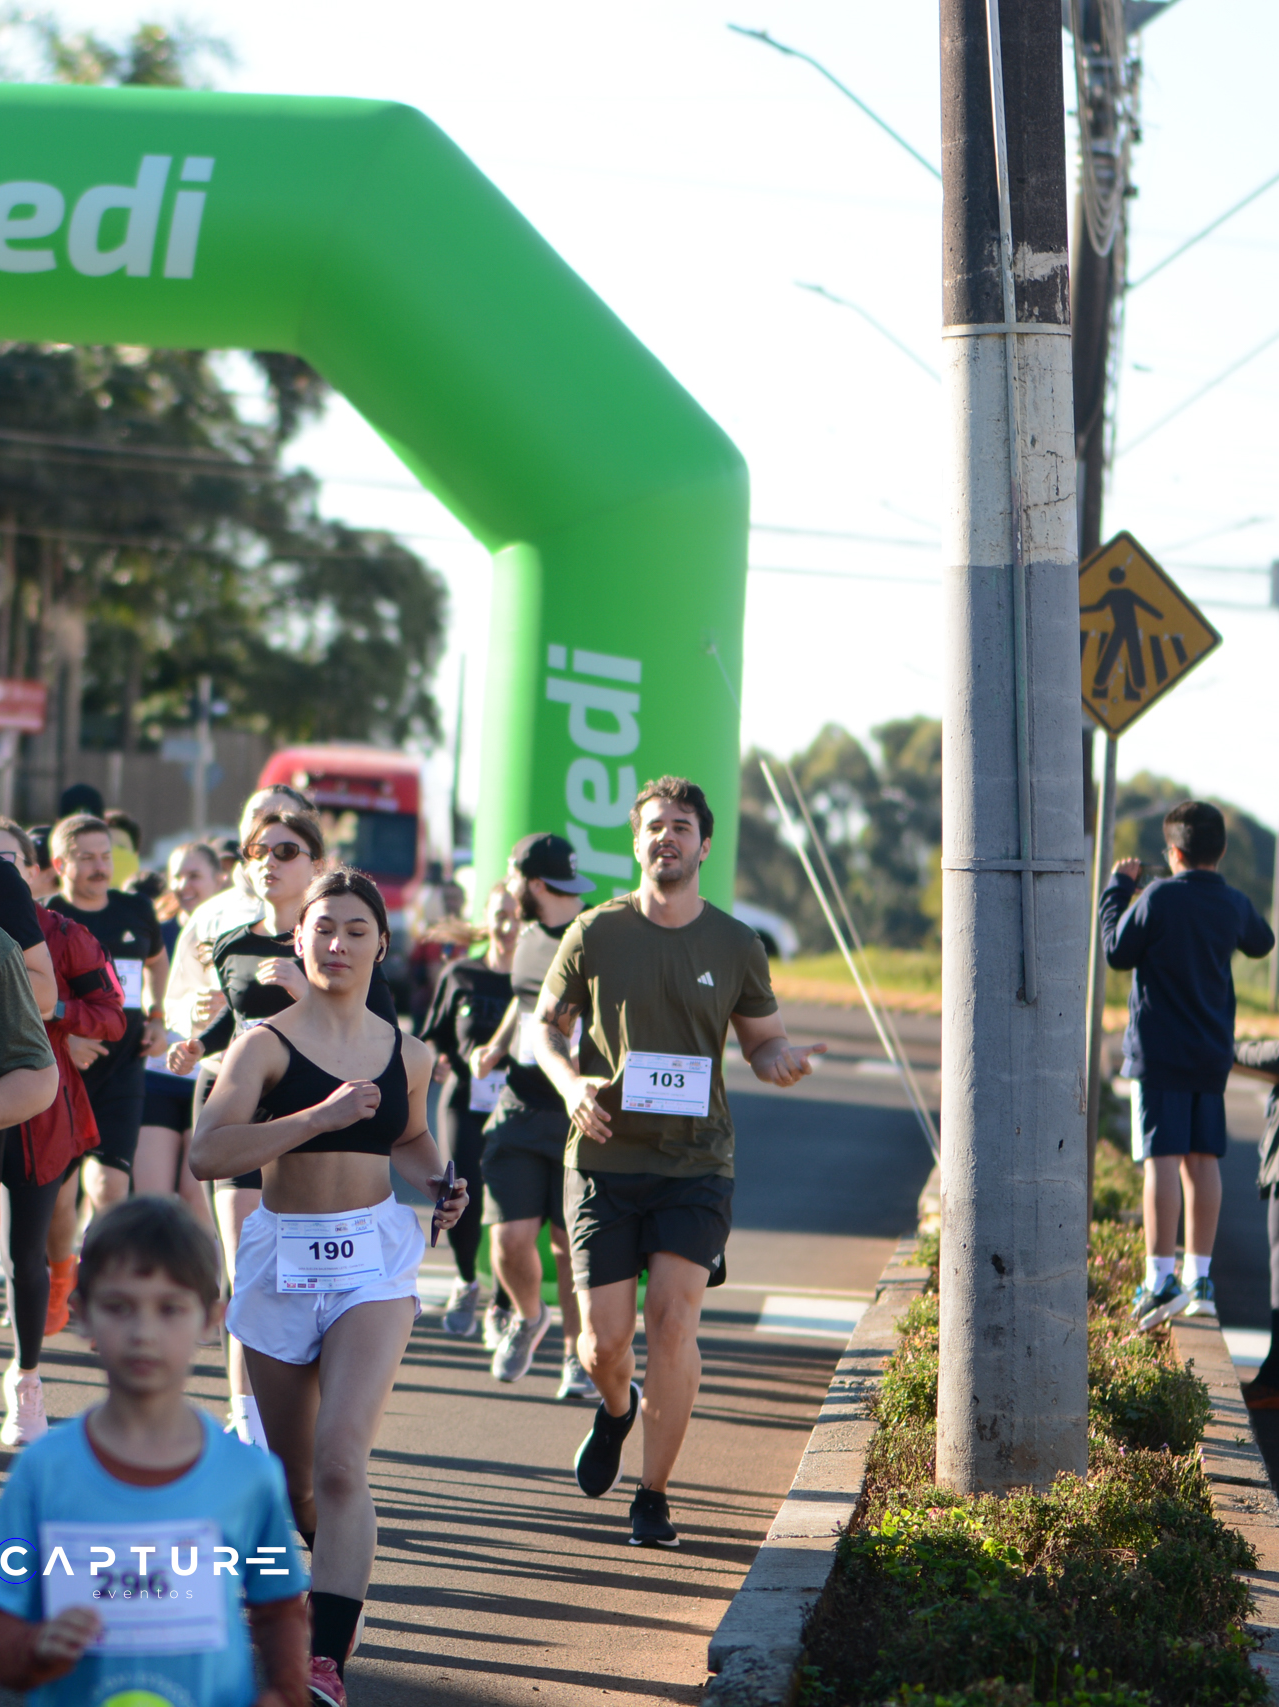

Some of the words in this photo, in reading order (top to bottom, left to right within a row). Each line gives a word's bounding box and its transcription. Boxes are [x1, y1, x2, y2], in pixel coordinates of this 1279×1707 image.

[546, 643, 642, 890] redi
[649, 1071, 685, 1088] 103
[309, 1239, 354, 1260] 190
